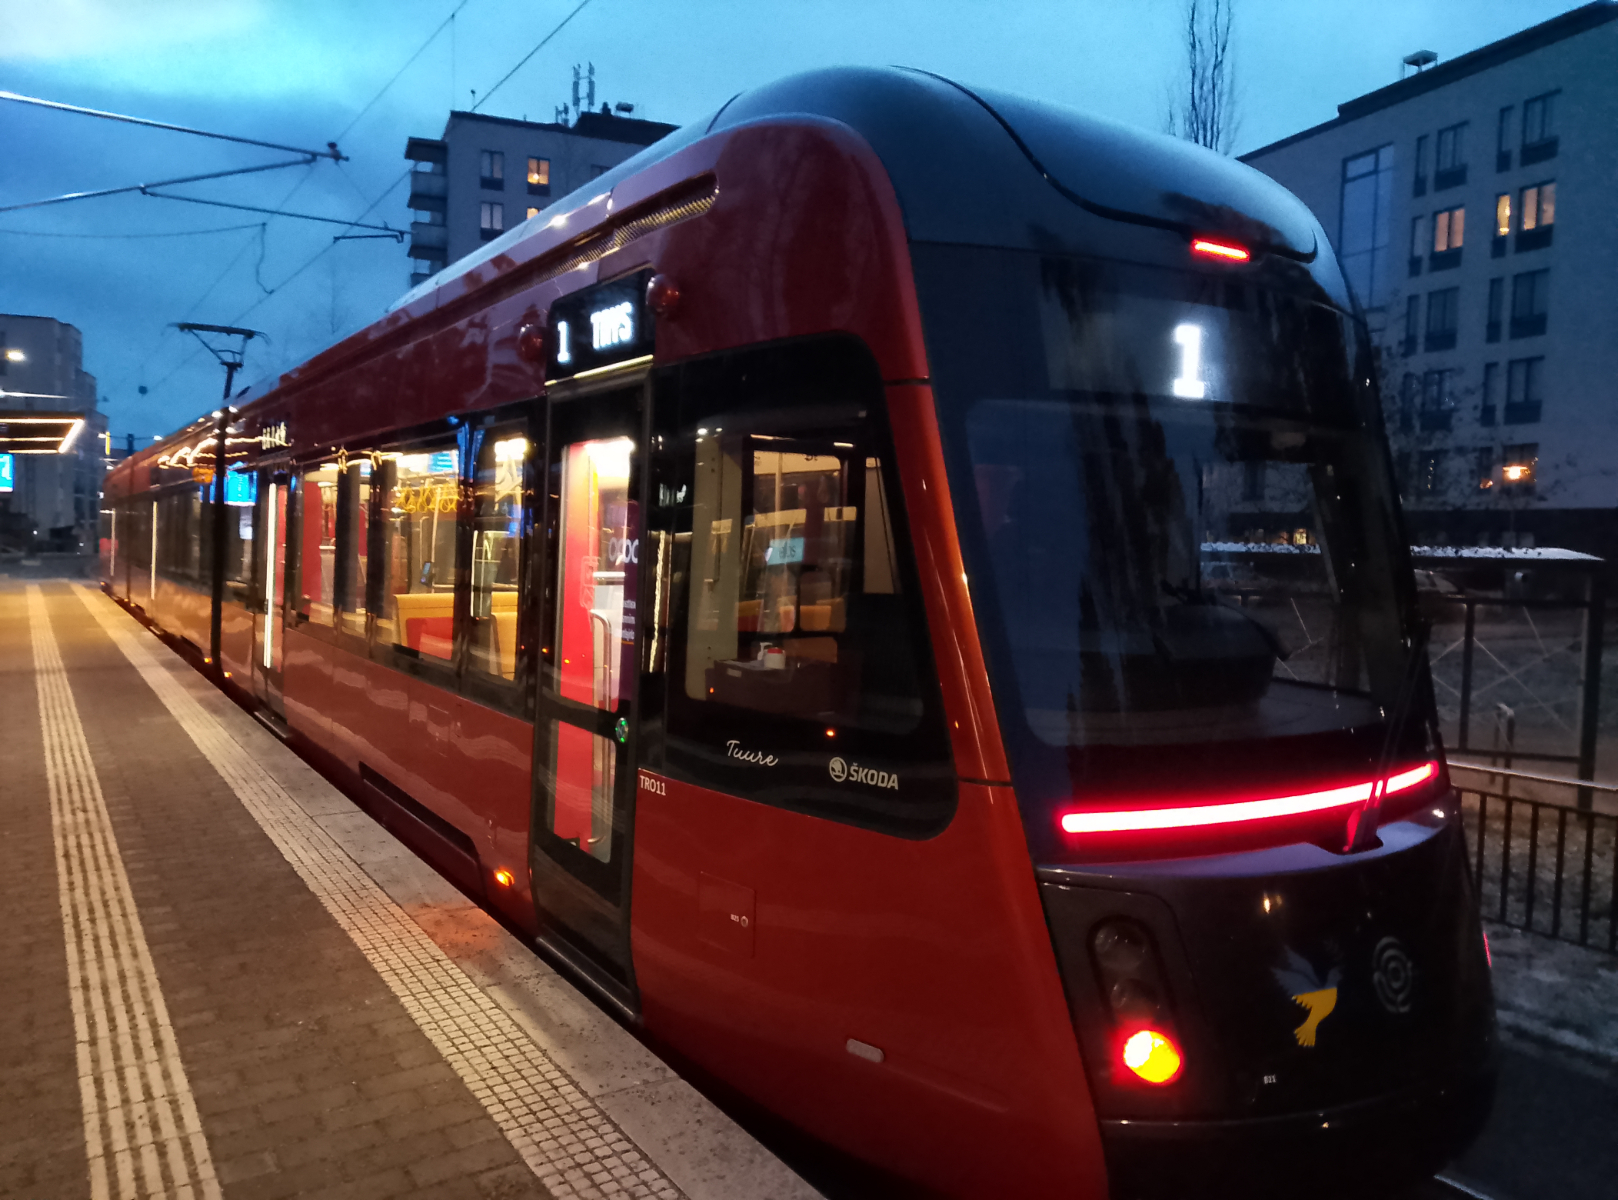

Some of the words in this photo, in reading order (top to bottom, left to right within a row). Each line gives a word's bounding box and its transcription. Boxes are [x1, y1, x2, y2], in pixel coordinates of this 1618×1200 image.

[557, 321, 569, 362] 1
[1173, 324, 1205, 399] 1
[726, 739, 779, 767] Tuure
[848, 762, 899, 790] ŠKODA
